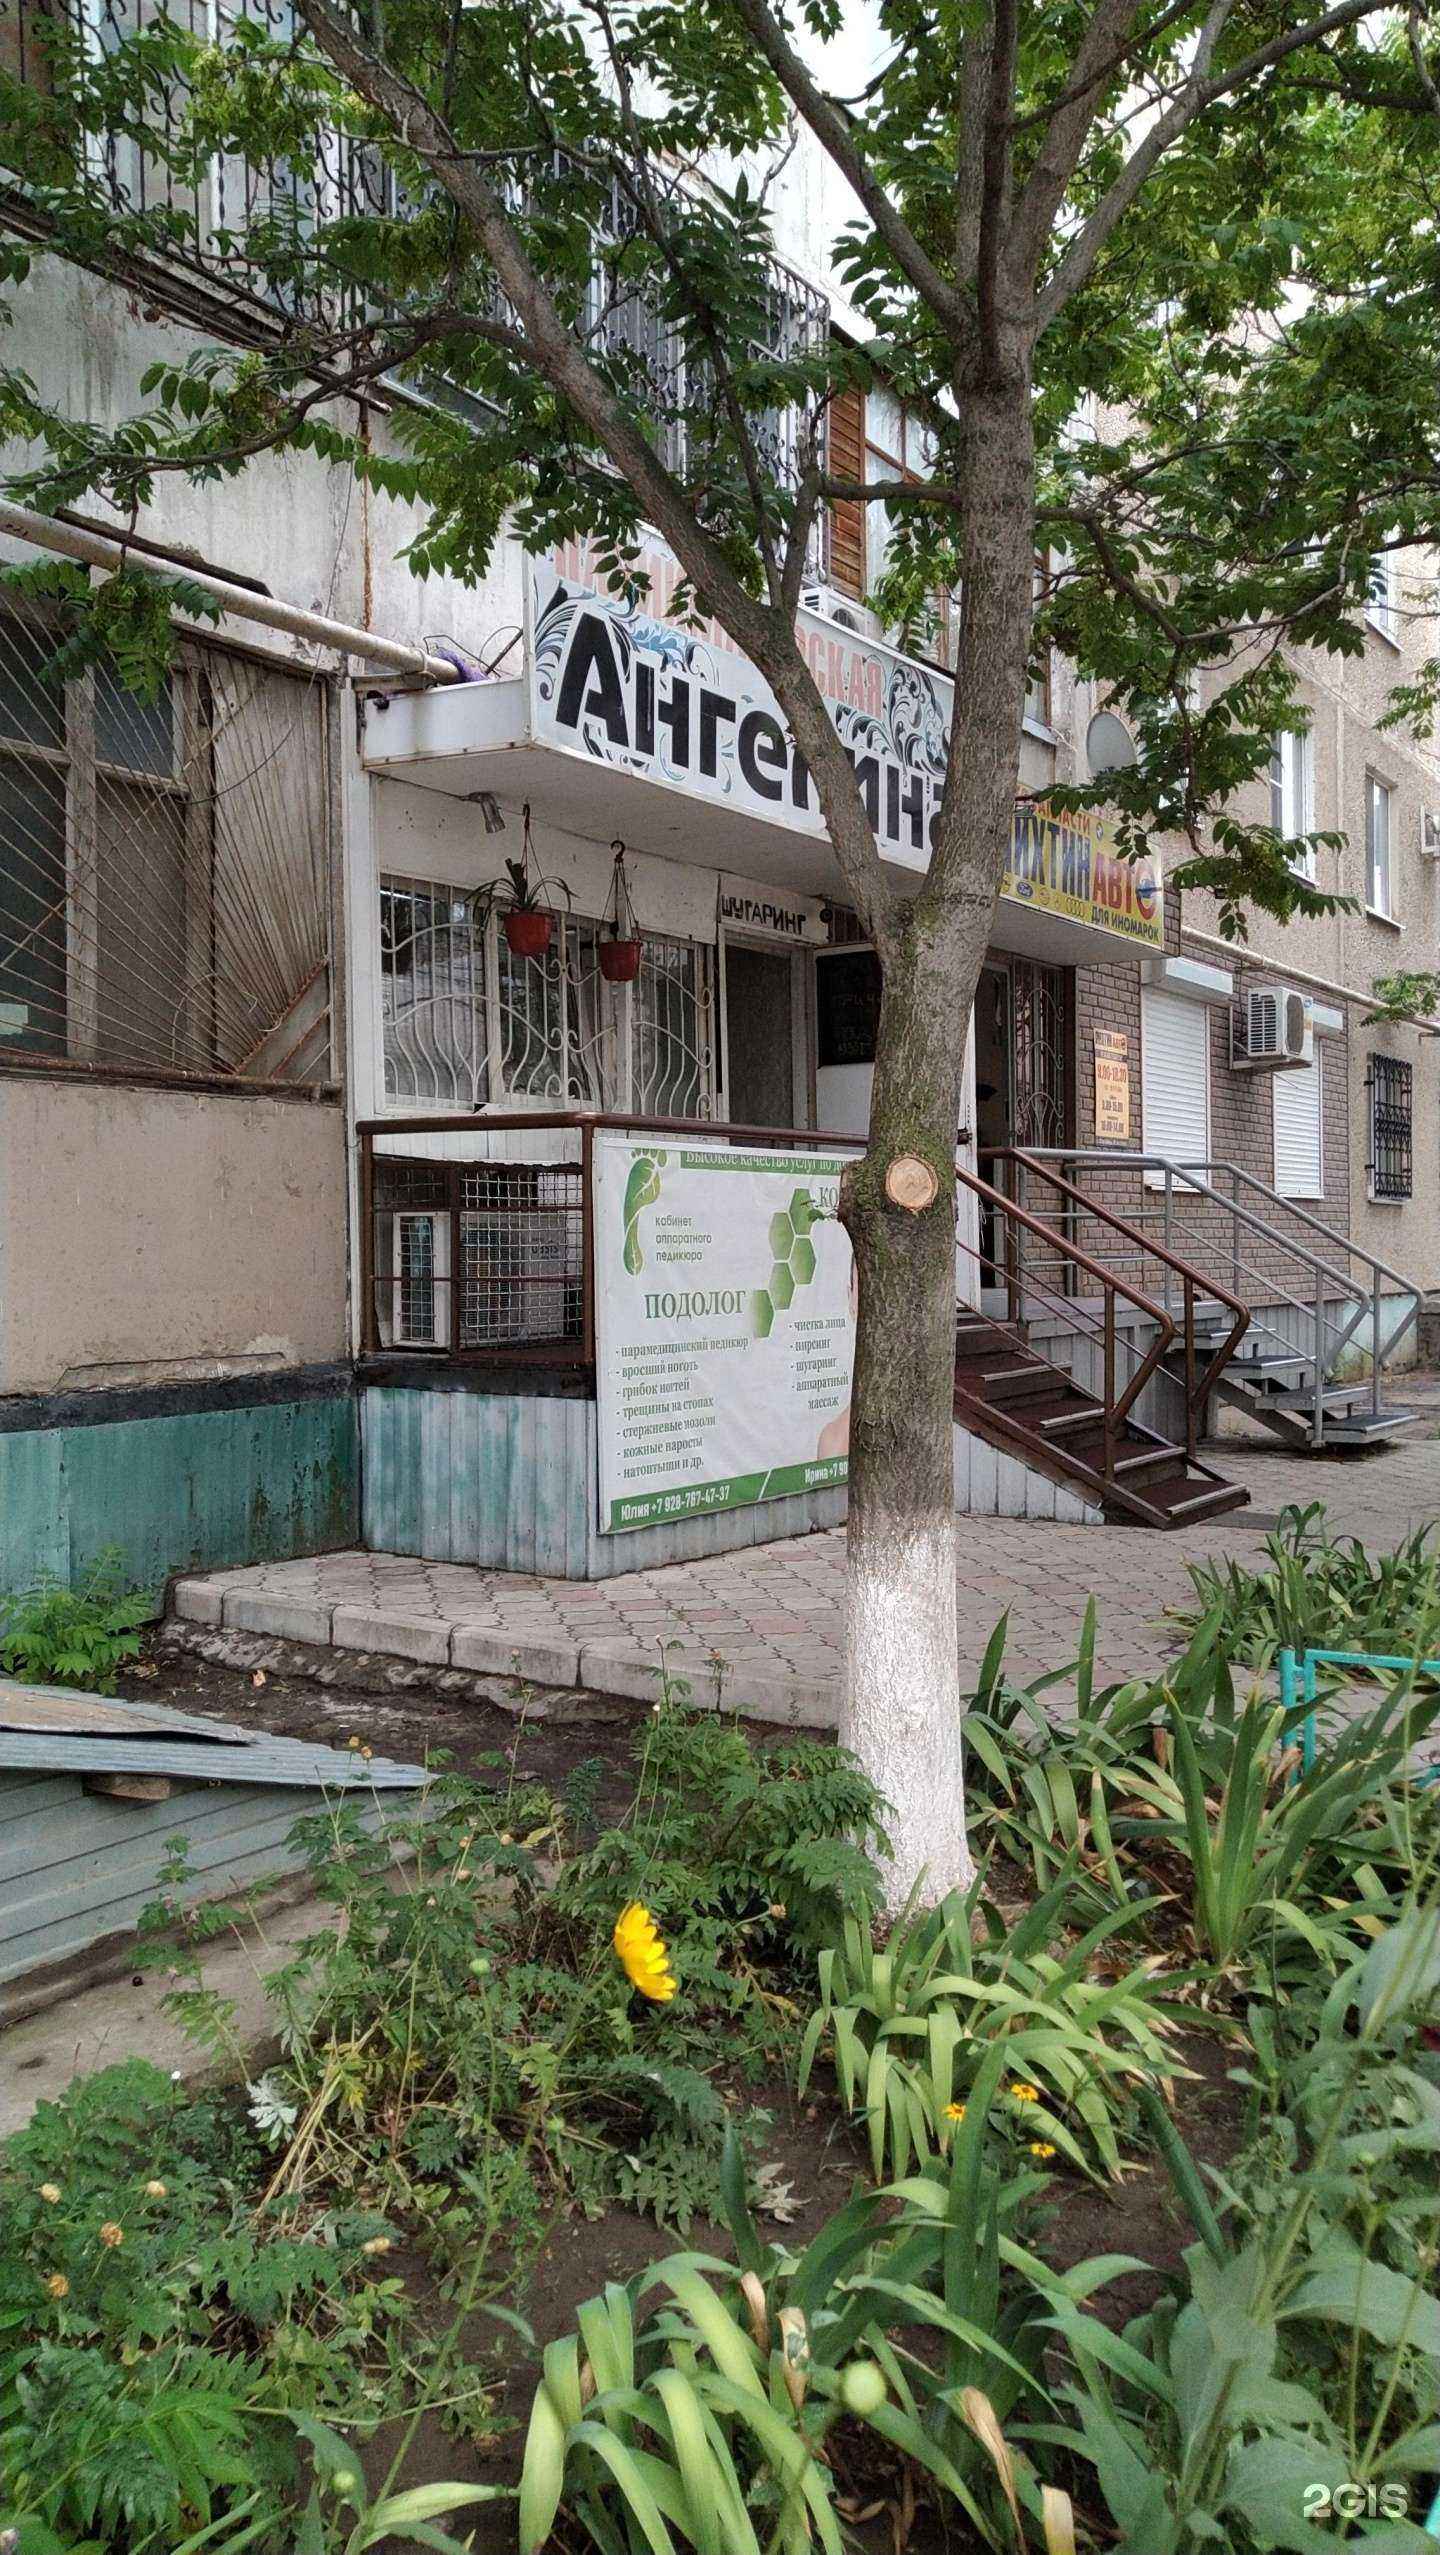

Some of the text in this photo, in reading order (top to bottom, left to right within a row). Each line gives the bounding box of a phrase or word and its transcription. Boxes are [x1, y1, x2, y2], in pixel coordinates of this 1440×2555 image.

[721, 895, 806, 935] ШУГАРИНГ
[1091, 905, 1160, 943] ДЛЯ ИНОМАРОК
[655, 1214, 692, 1227] кабинет
[655, 1234, 712, 1246] аппаратного
[656, 1250, 703, 1264] педикюра
[644, 1290, 746, 1323] ПОДОЛОГ
[794, 1318, 846, 1332] чистка лица
[621, 1337, 749, 1359] парамедицинский педикюр
[795, 1338, 831, 1354] пирсинг
[622, 1360, 699, 1380] вросший ноготь
[796, 1357, 837, 1374] шугаринг
[622, 1378, 690, 1401] грибок ногтей
[796, 1370, 849, 1393] аппаратный
[622, 1397, 714, 1421] трещины на стопах
[808, 1396, 840, 1410] массаж
[622, 1416, 716, 1440] стержневые мозоли
[623, 1437, 703, 1459] кожные наросты
[623, 1461, 680, 1479] натоптыши
[682, 1458, 688, 1469] и
[804, 1467, 828, 1486] Ирина
[621, 1503, 650, 1521] Юлия
[651, 1498, 663, 1514] +7
